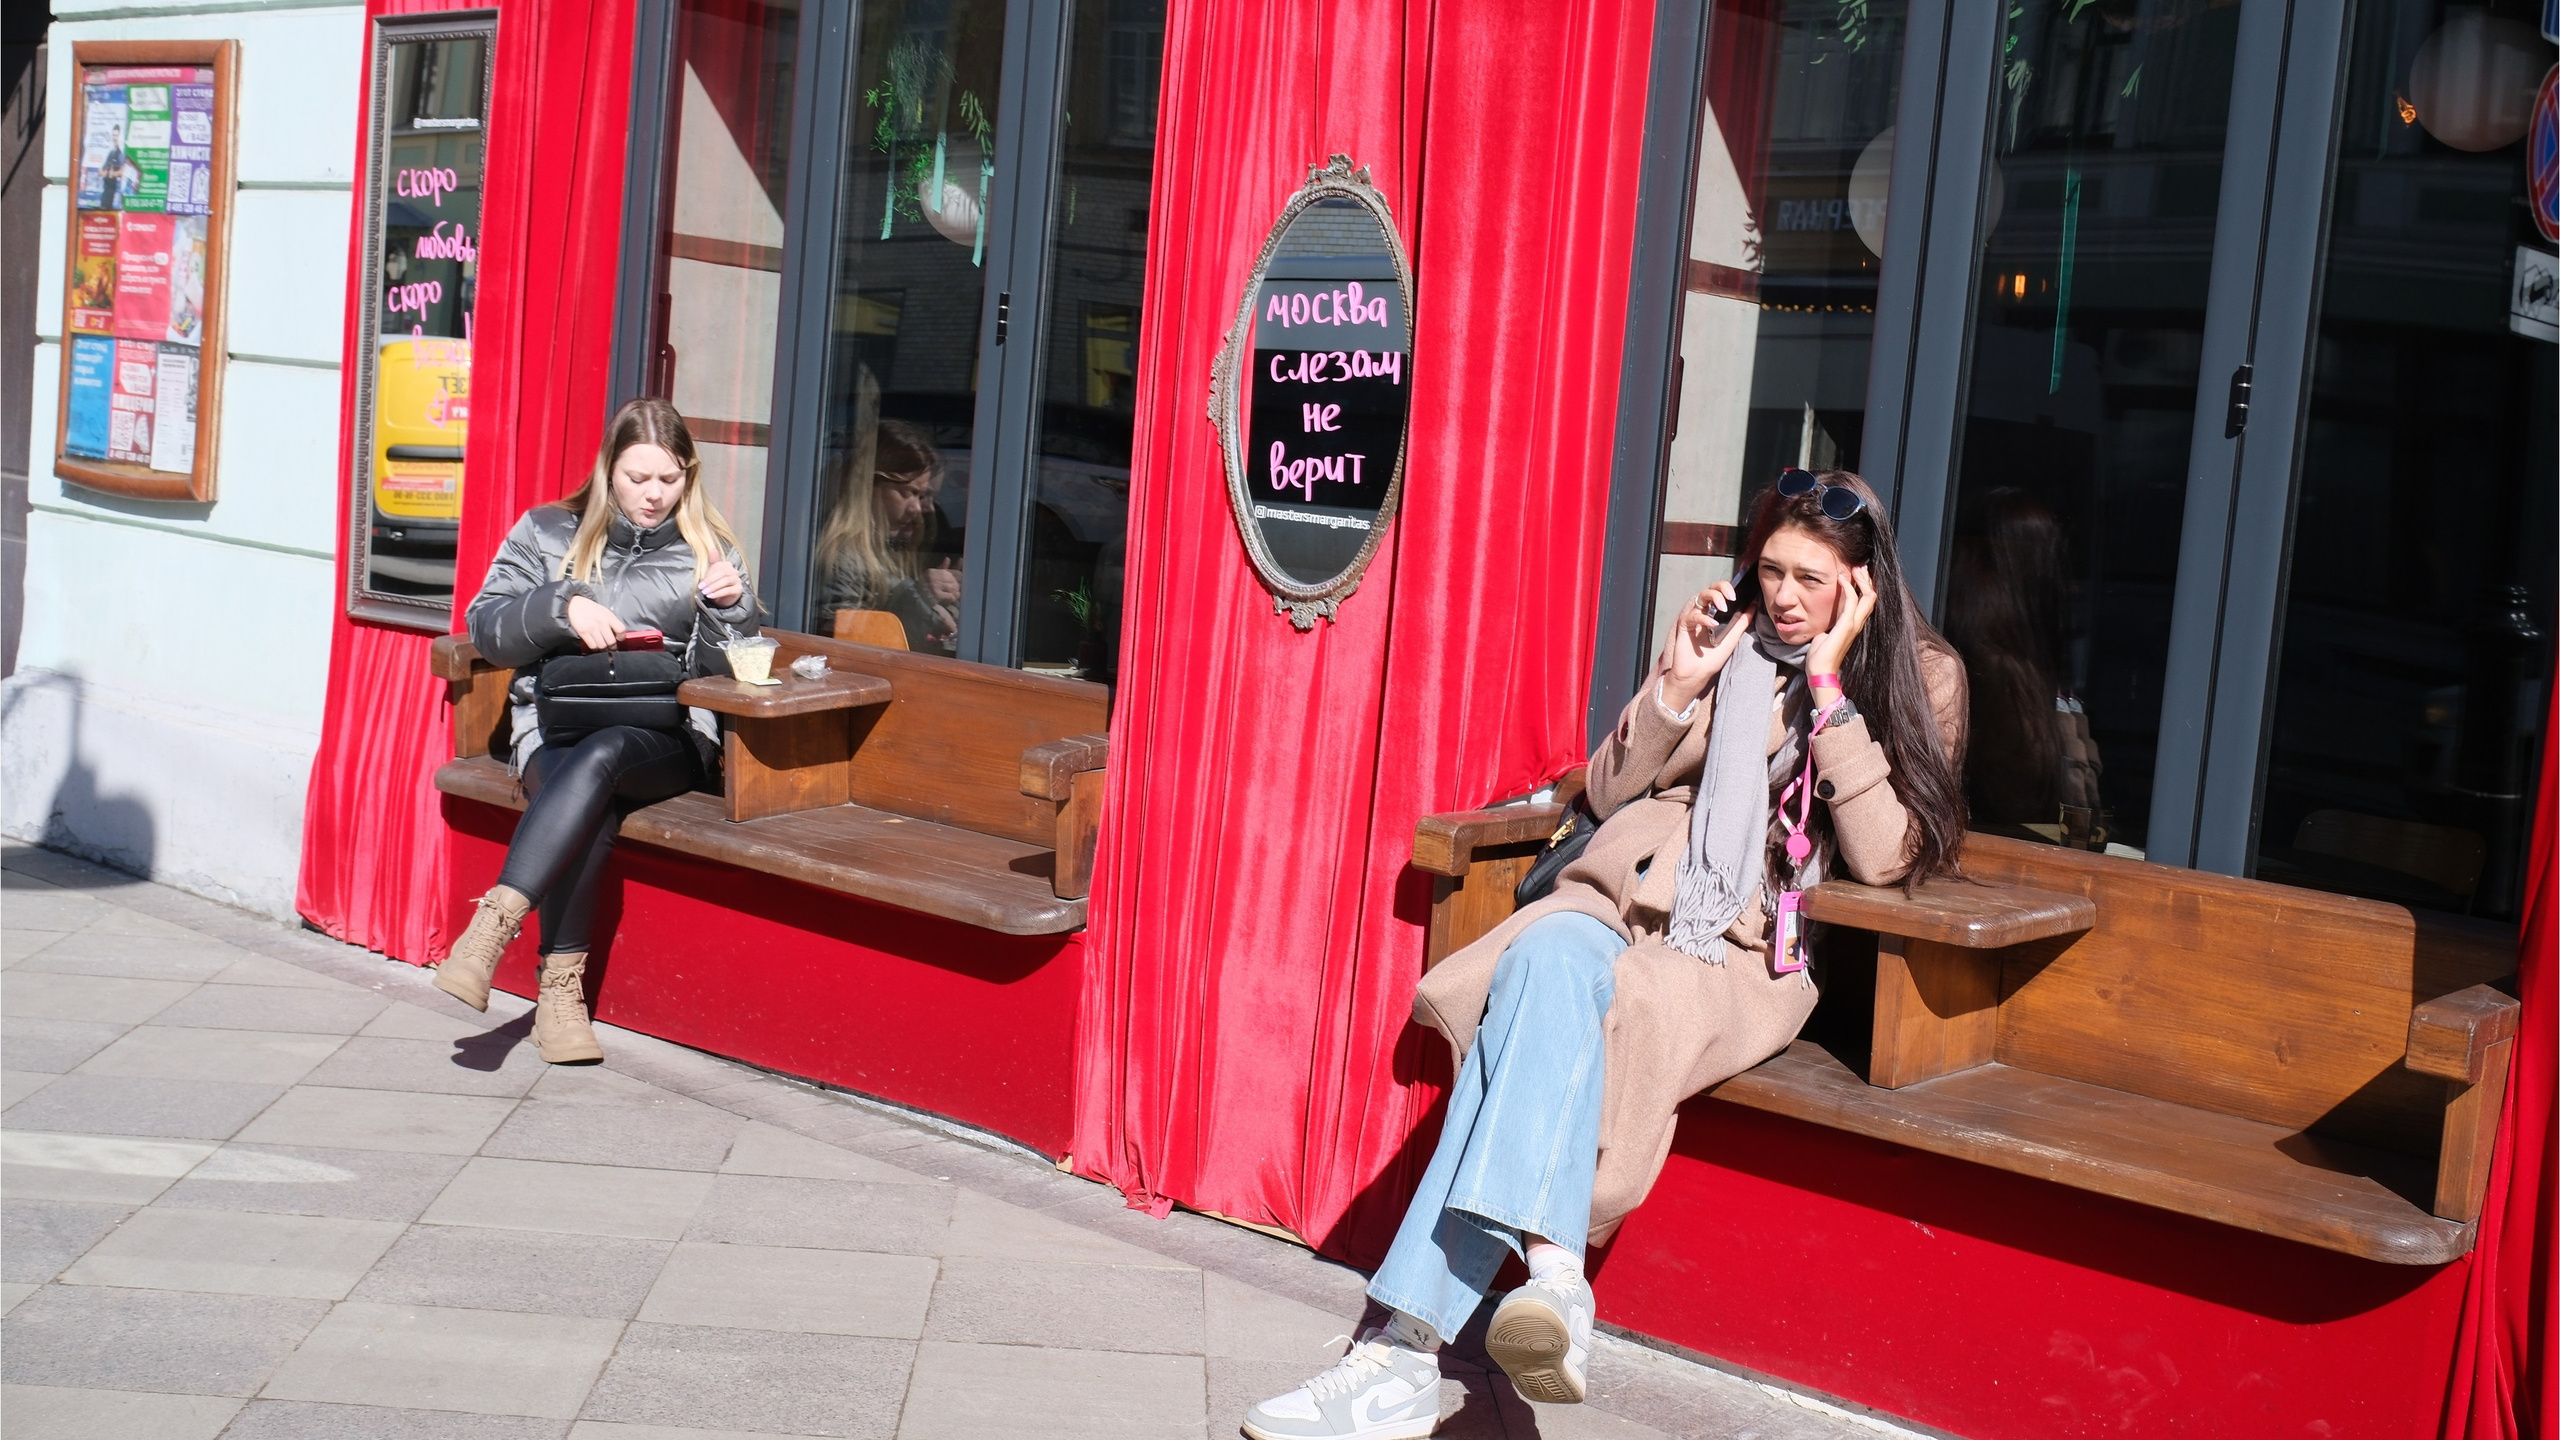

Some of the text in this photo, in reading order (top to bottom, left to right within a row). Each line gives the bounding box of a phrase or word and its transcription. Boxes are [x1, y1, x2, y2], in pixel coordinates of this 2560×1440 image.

[397, 166, 458, 208] скоро
[415, 220, 477, 263] любовь
[388, 280, 443, 322] скоро
[1266, 281, 1389, 328] москва
[1270, 349, 1402, 386] слезам
[1302, 402, 1341, 433] не
[1269, 440, 1366, 502] верит
[1266, 507, 1371, 531] mastersmargaritas
